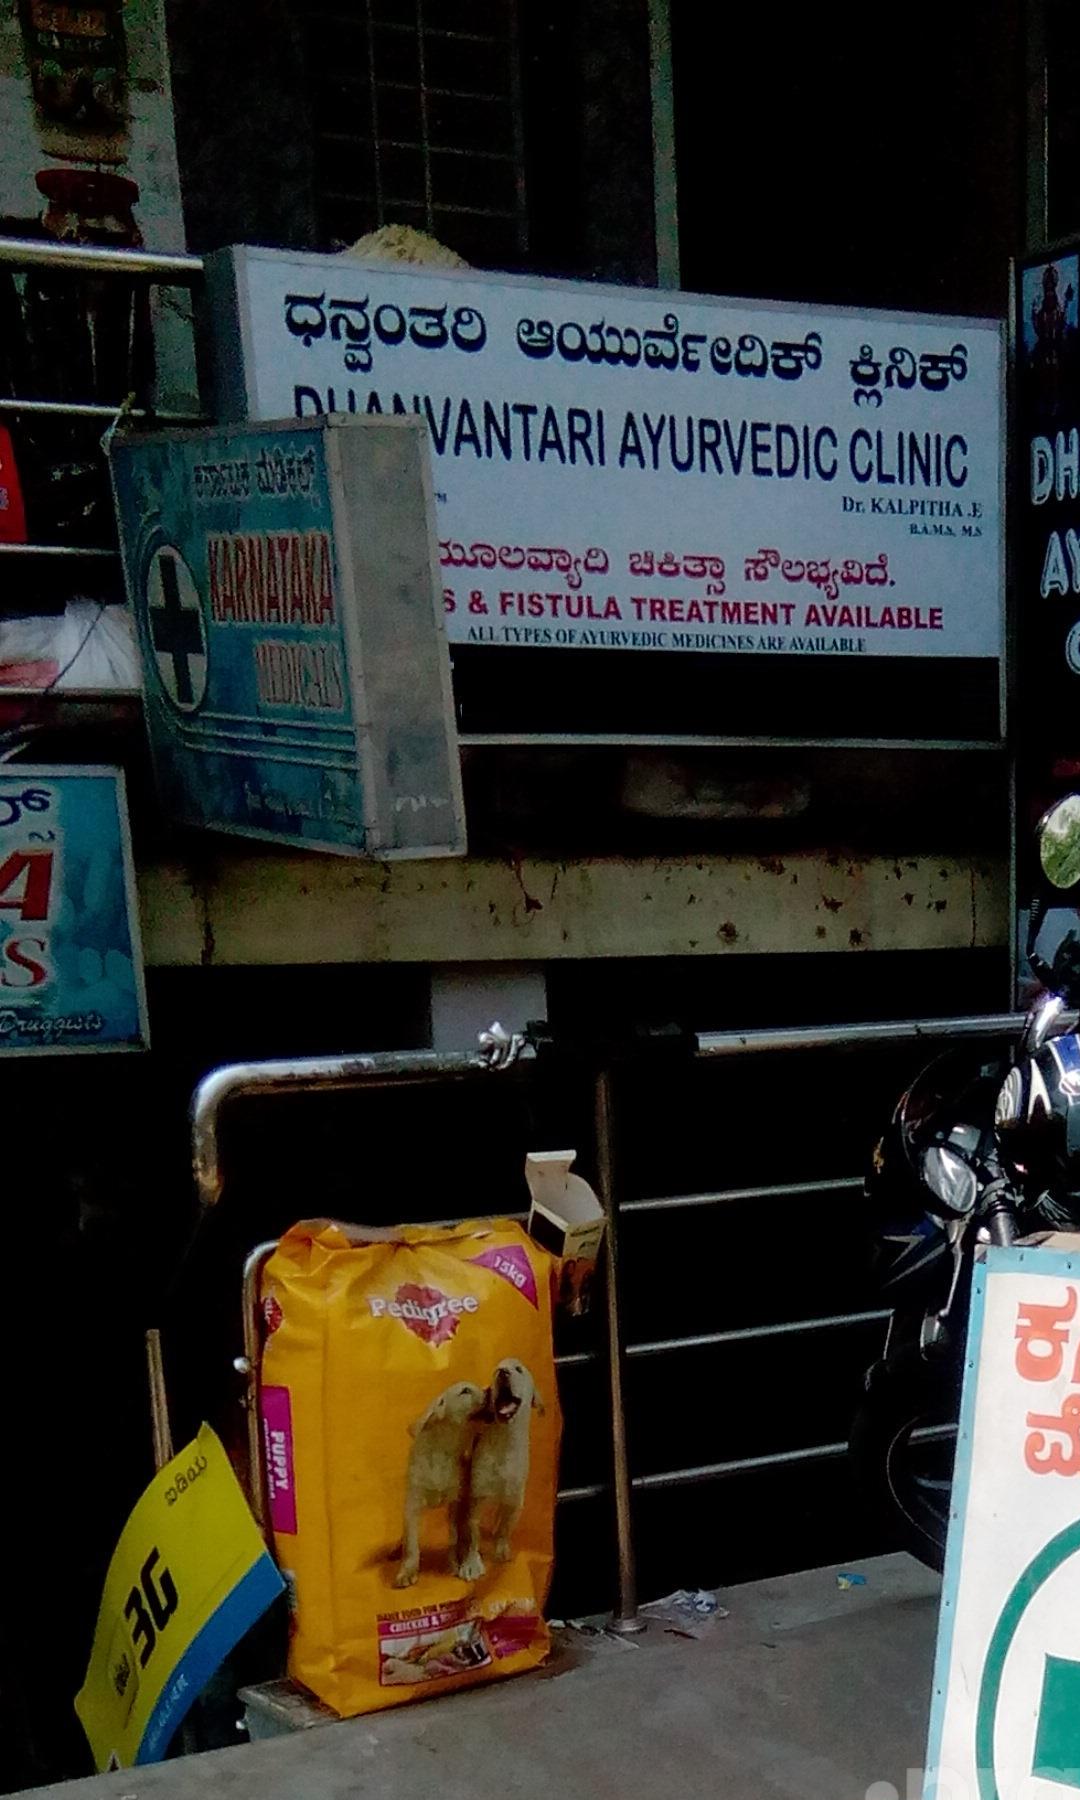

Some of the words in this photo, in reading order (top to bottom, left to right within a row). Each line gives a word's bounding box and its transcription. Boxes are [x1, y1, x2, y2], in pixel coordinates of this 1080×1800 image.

[284, 292, 487, 372] ಧನ್ವಂತರಿ
[849, 341, 968, 407] ಕ್ಲಿನಿಕ್
[619, 411, 839, 484] AYURVEDIC
[849, 427, 968, 488] CLINIC
[842, 496, 865, 513] Dr.
[871, 498, 963, 517] KALPITHA
[208, 533, 336, 624] KARNATAKA
[469, 590, 488, 615] &
[500, 592, 622, 620] FISTULA
[631, 598, 797, 628] TREATMENT
[806, 602, 944, 631] AVAILABLE
[501, 627, 552, 643] TYPES
[555, 629, 576, 644] OF
[580, 630, 668, 648] AYURVEDIC
[671, 633, 754, 650] MEDICINES
[756, 636, 787, 651] ARE
[788, 637, 867, 652] AVAILABLE
[367, 1295, 479, 1327] Pedigree
[269, 1430, 289, 1492] PUPPY
[123, 1547, 178, 1669] 3G
